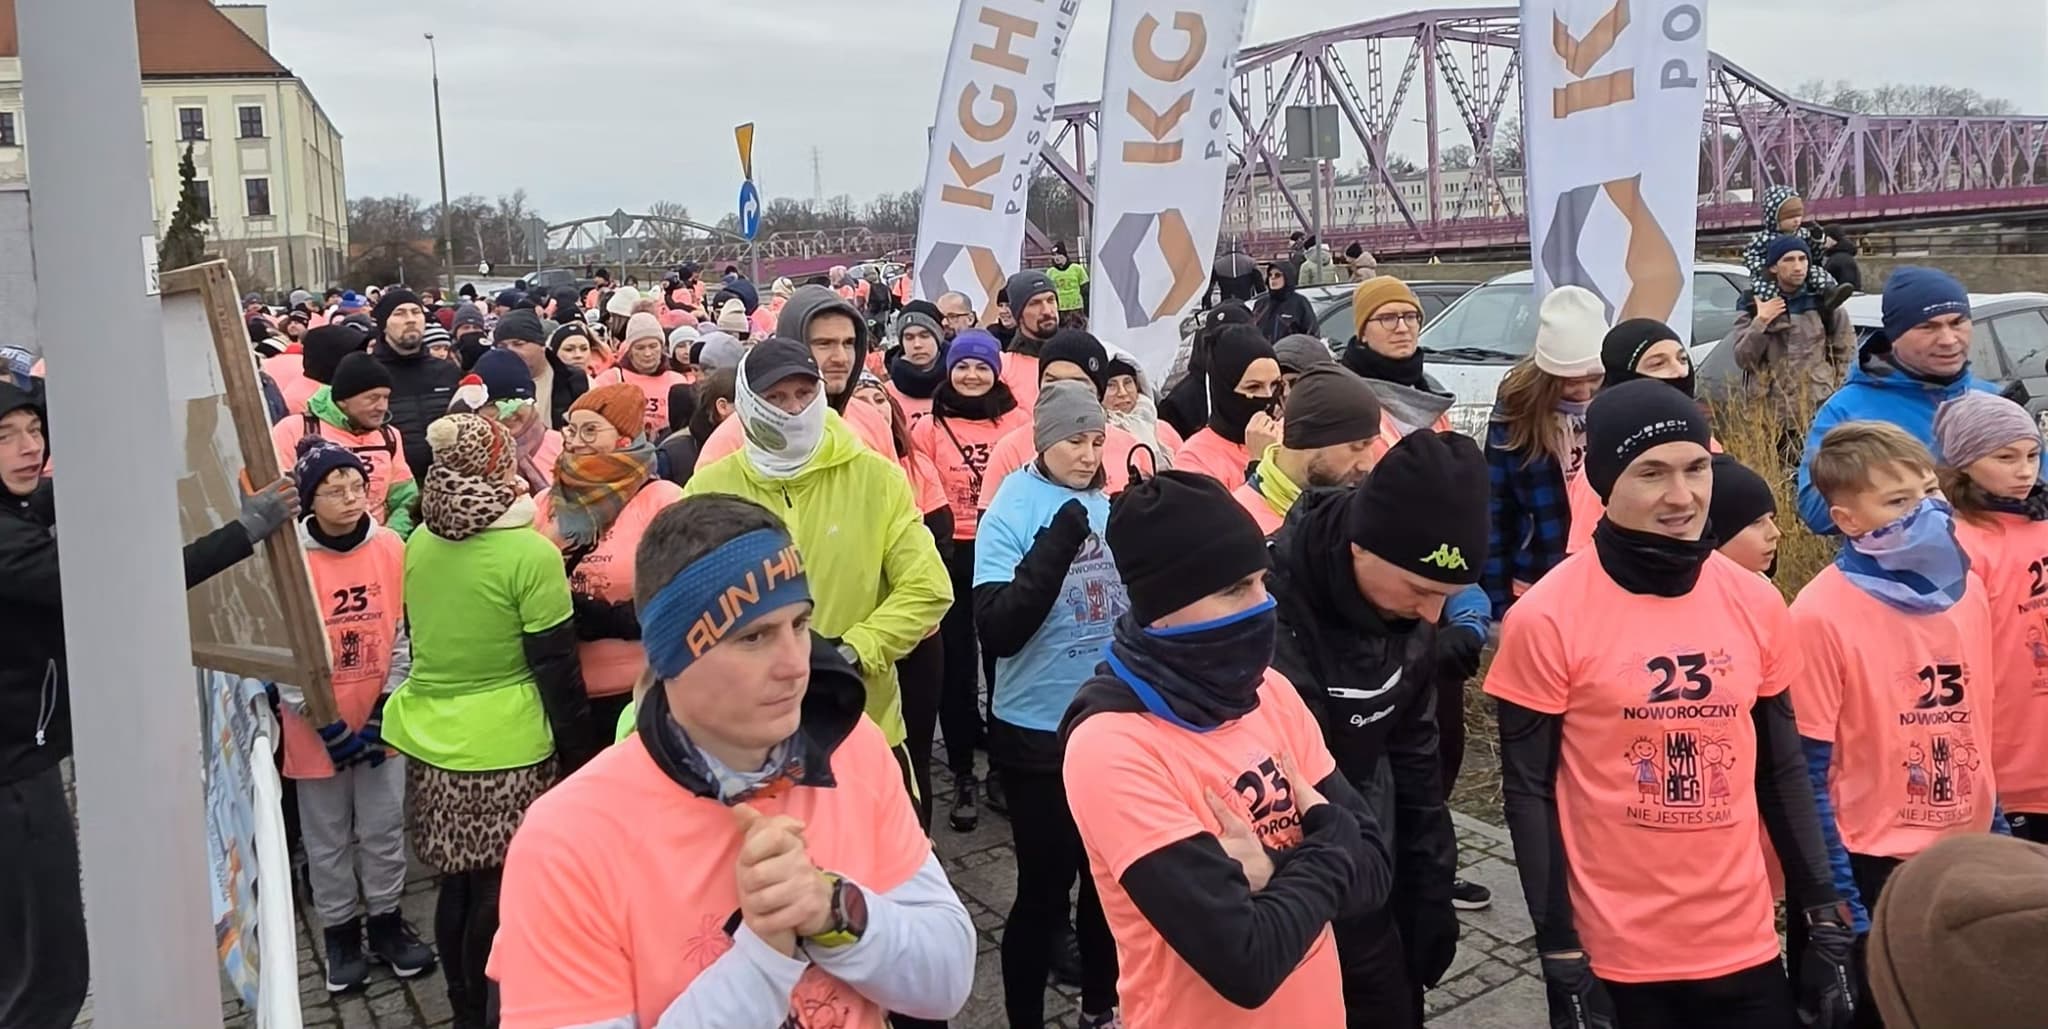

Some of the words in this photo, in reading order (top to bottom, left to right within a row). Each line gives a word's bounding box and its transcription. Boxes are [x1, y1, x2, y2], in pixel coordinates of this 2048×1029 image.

[1553, 0, 1635, 119] K
[1660, 4, 1700, 90] PO
[941, 0, 1045, 211] KGH
[1122, 11, 1207, 163] KG
[1005, 82, 1056, 215] POLSKA
[961, 443, 989, 465] 23
[331, 584, 368, 616] 23
[686, 571, 760, 659] RUN
[1623, 703, 1739, 721] NOWOROCZNY
[1646, 652, 1712, 704] 23
[1913, 663, 1965, 710] 23
[1234, 756, 1294, 824] 23
[1626, 804, 1651, 820] NIE
[1654, 809, 1704, 825] JESTEŚ
[1706, 808, 1732, 823] SAM
